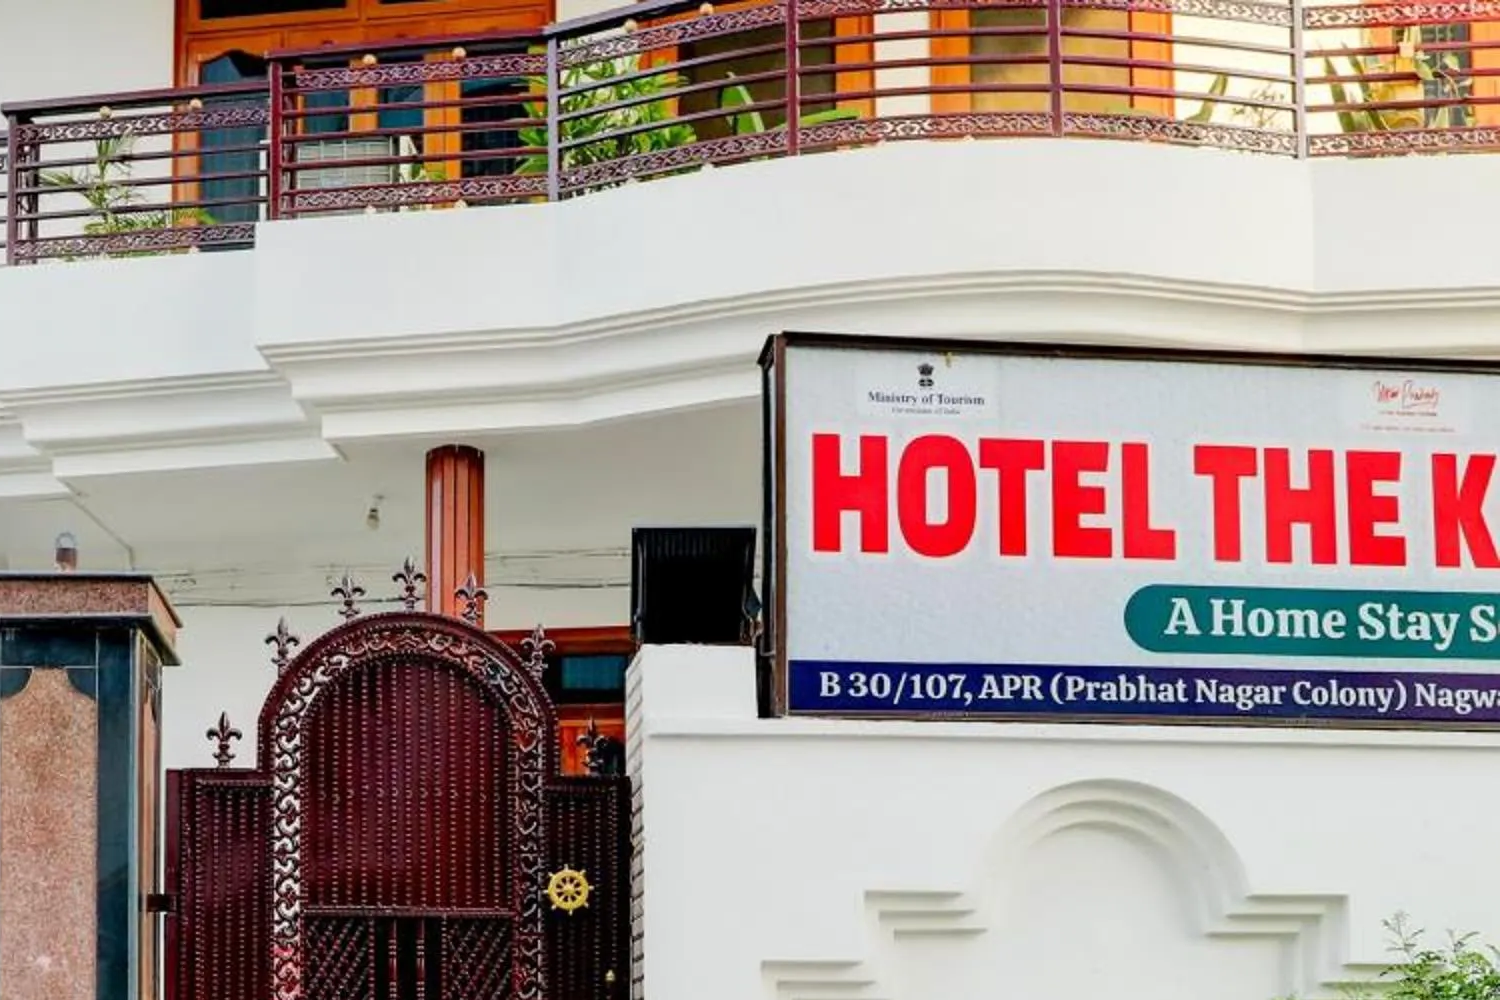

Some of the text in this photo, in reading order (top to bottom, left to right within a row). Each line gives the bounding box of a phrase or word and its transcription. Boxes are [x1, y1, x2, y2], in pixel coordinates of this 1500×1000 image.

[868, 391, 985, 406] Ministry of Tourism
[812, 433, 1176, 560] HOTEL
[1193, 445, 1407, 567] THE
[1163, 597, 1500, 651] A Home Stay S
[819, 671, 841, 697] B
[977, 674, 1044, 700] APR
[1049, 672, 1189, 706] (Prabhat
[1194, 678, 1287, 711] Nagar
[1291, 678, 1407, 713] Colony)
[1413, 681, 1500, 715] Nagw
